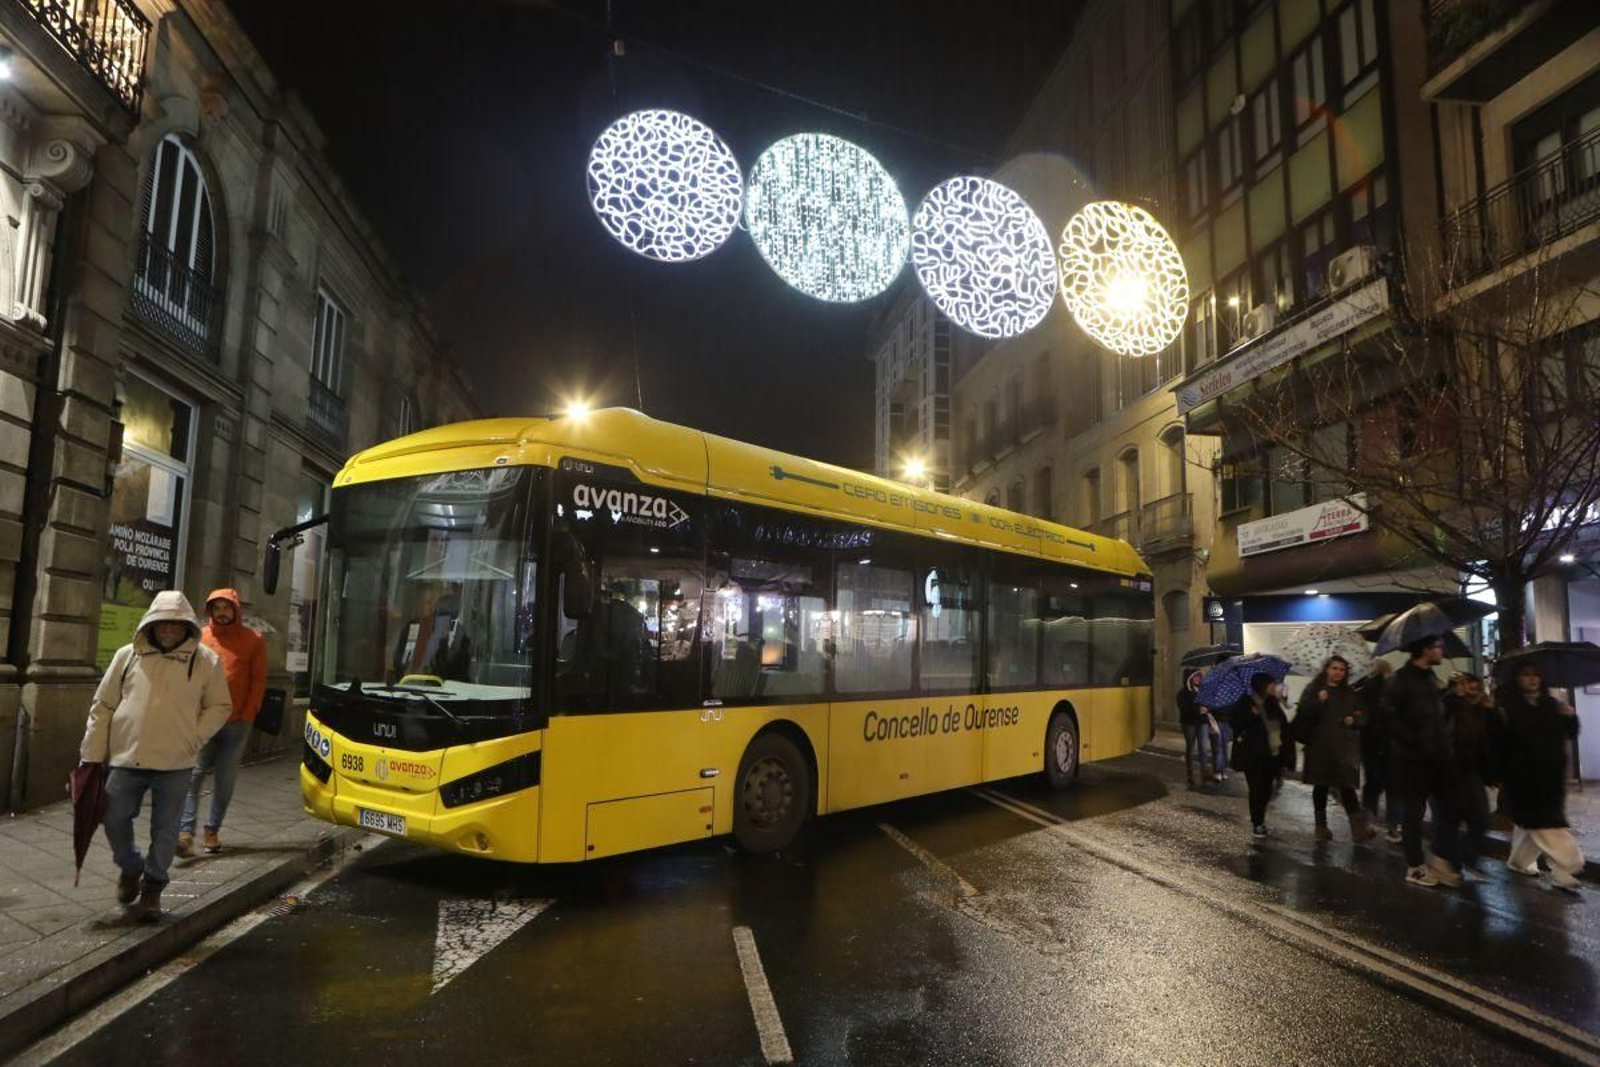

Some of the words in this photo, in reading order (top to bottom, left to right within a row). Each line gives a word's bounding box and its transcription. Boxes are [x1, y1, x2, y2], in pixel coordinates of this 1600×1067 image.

[573, 484, 669, 520] avanza
[108, 523, 134, 540] AMIÑO
[113, 537, 134, 553] POLA
[135, 543, 170, 562] PROVINCIA
[126, 554, 137, 566] DE
[138, 557, 170, 574] OURENSE
[863, 710, 938, 742] Concello
[942, 705, 961, 734] de
[964, 703, 1020, 731] Ourense
[342, 753, 364, 772] 6938
[389, 760, 427, 775] avanza
[364, 811, 385, 828] 6695
